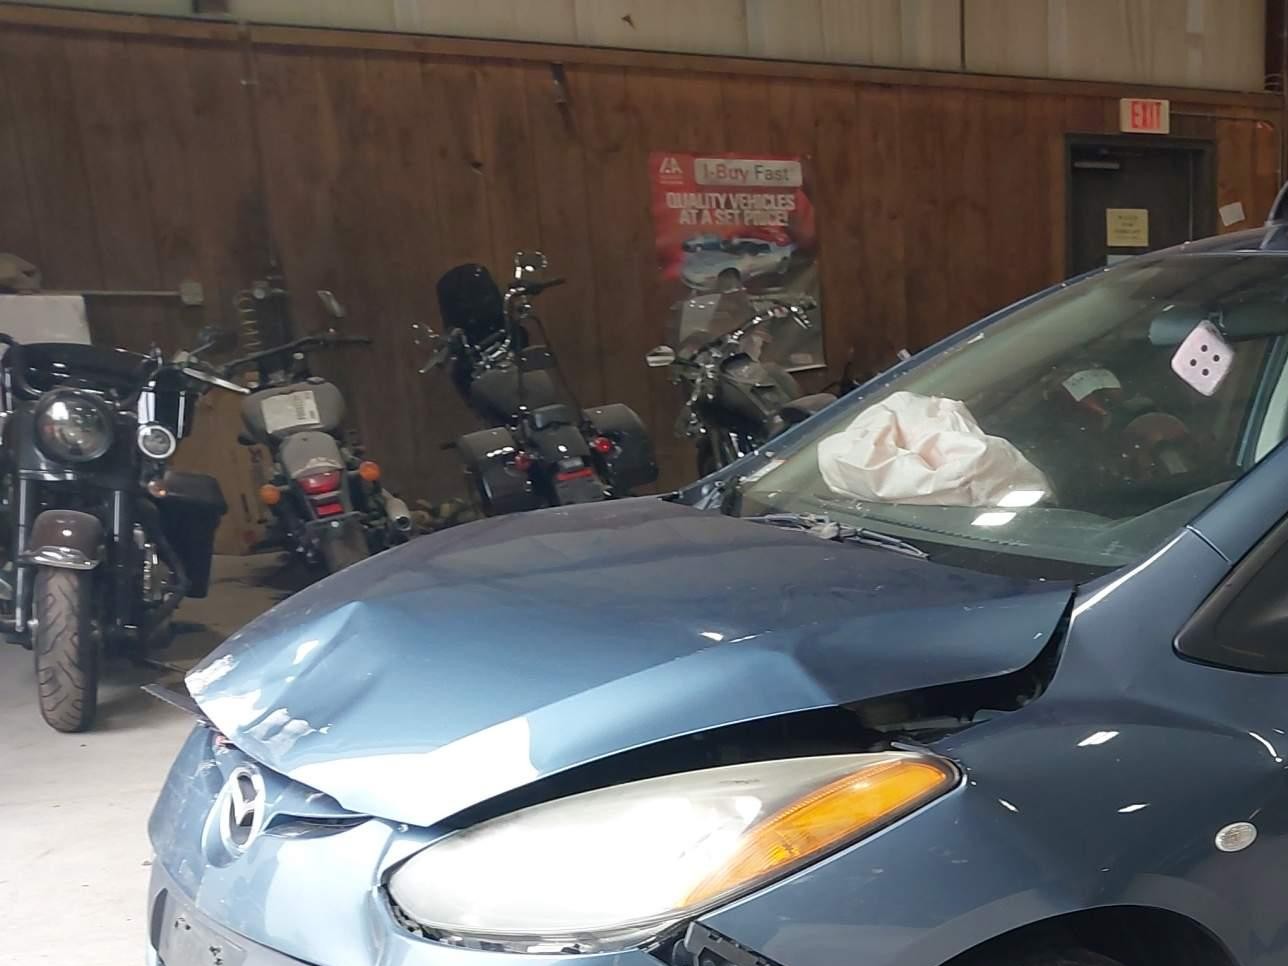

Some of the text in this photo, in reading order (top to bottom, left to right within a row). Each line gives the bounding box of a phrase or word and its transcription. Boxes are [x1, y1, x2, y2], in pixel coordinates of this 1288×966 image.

[1131, 101, 1162, 128] EXIT
[704, 162, 750, 183] I-Buy
[754, 164, 790, 182] Fast
[666, 192, 796, 211] QUALITY VEHICLES
[680, 209, 789, 227] AT A SET PRICE!
